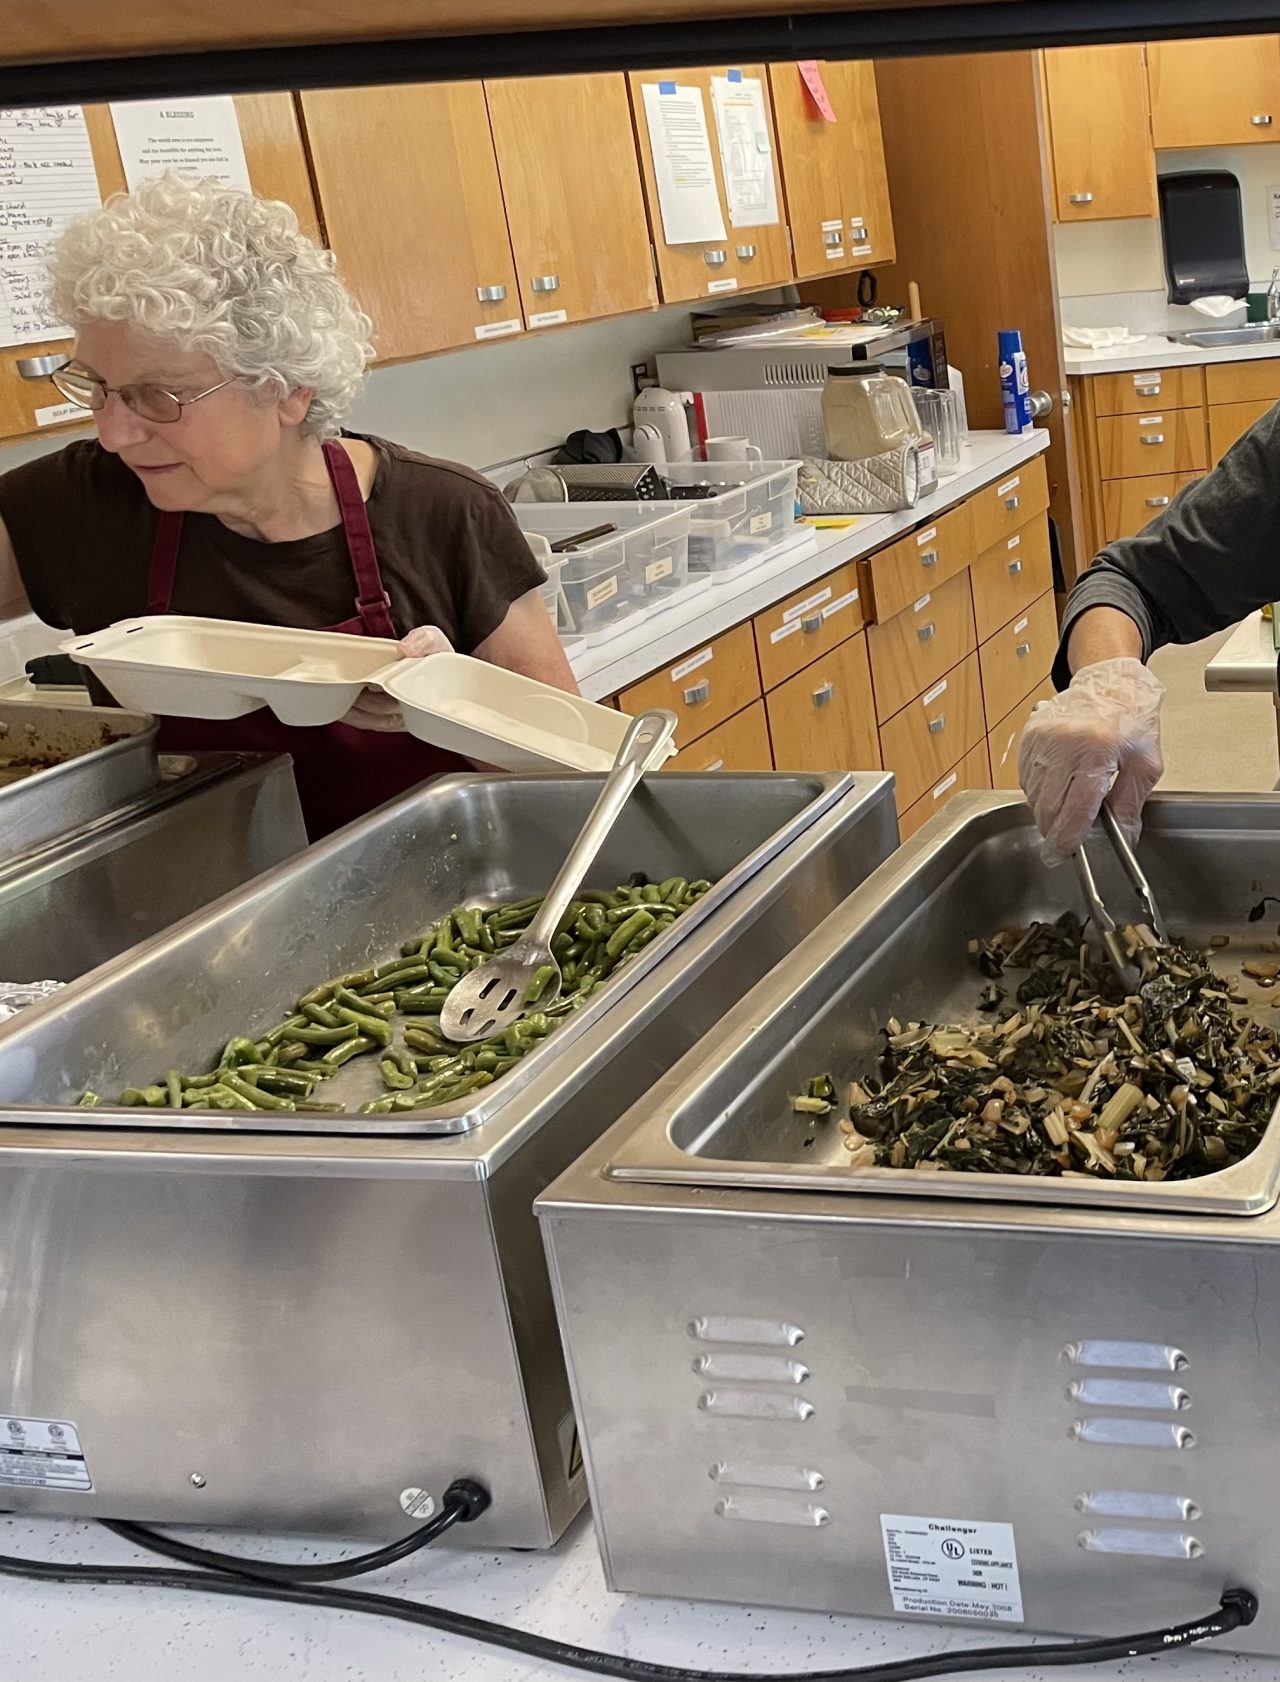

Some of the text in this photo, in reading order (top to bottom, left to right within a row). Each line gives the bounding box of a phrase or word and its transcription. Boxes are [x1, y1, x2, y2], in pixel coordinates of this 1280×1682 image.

[53, 409, 68, 417] SOUP
[928, 1523, 977, 1534] Challenger
[946, 1542, 961, 1556] UL
[969, 1548, 993, 1556] LISTED
[990, 1560, 1013, 1569] APPLIANCE
[958, 1579, 986, 1589] WARNING
[903, 1596, 948, 1606] Production
[904, 1603, 928, 1611] Serial
